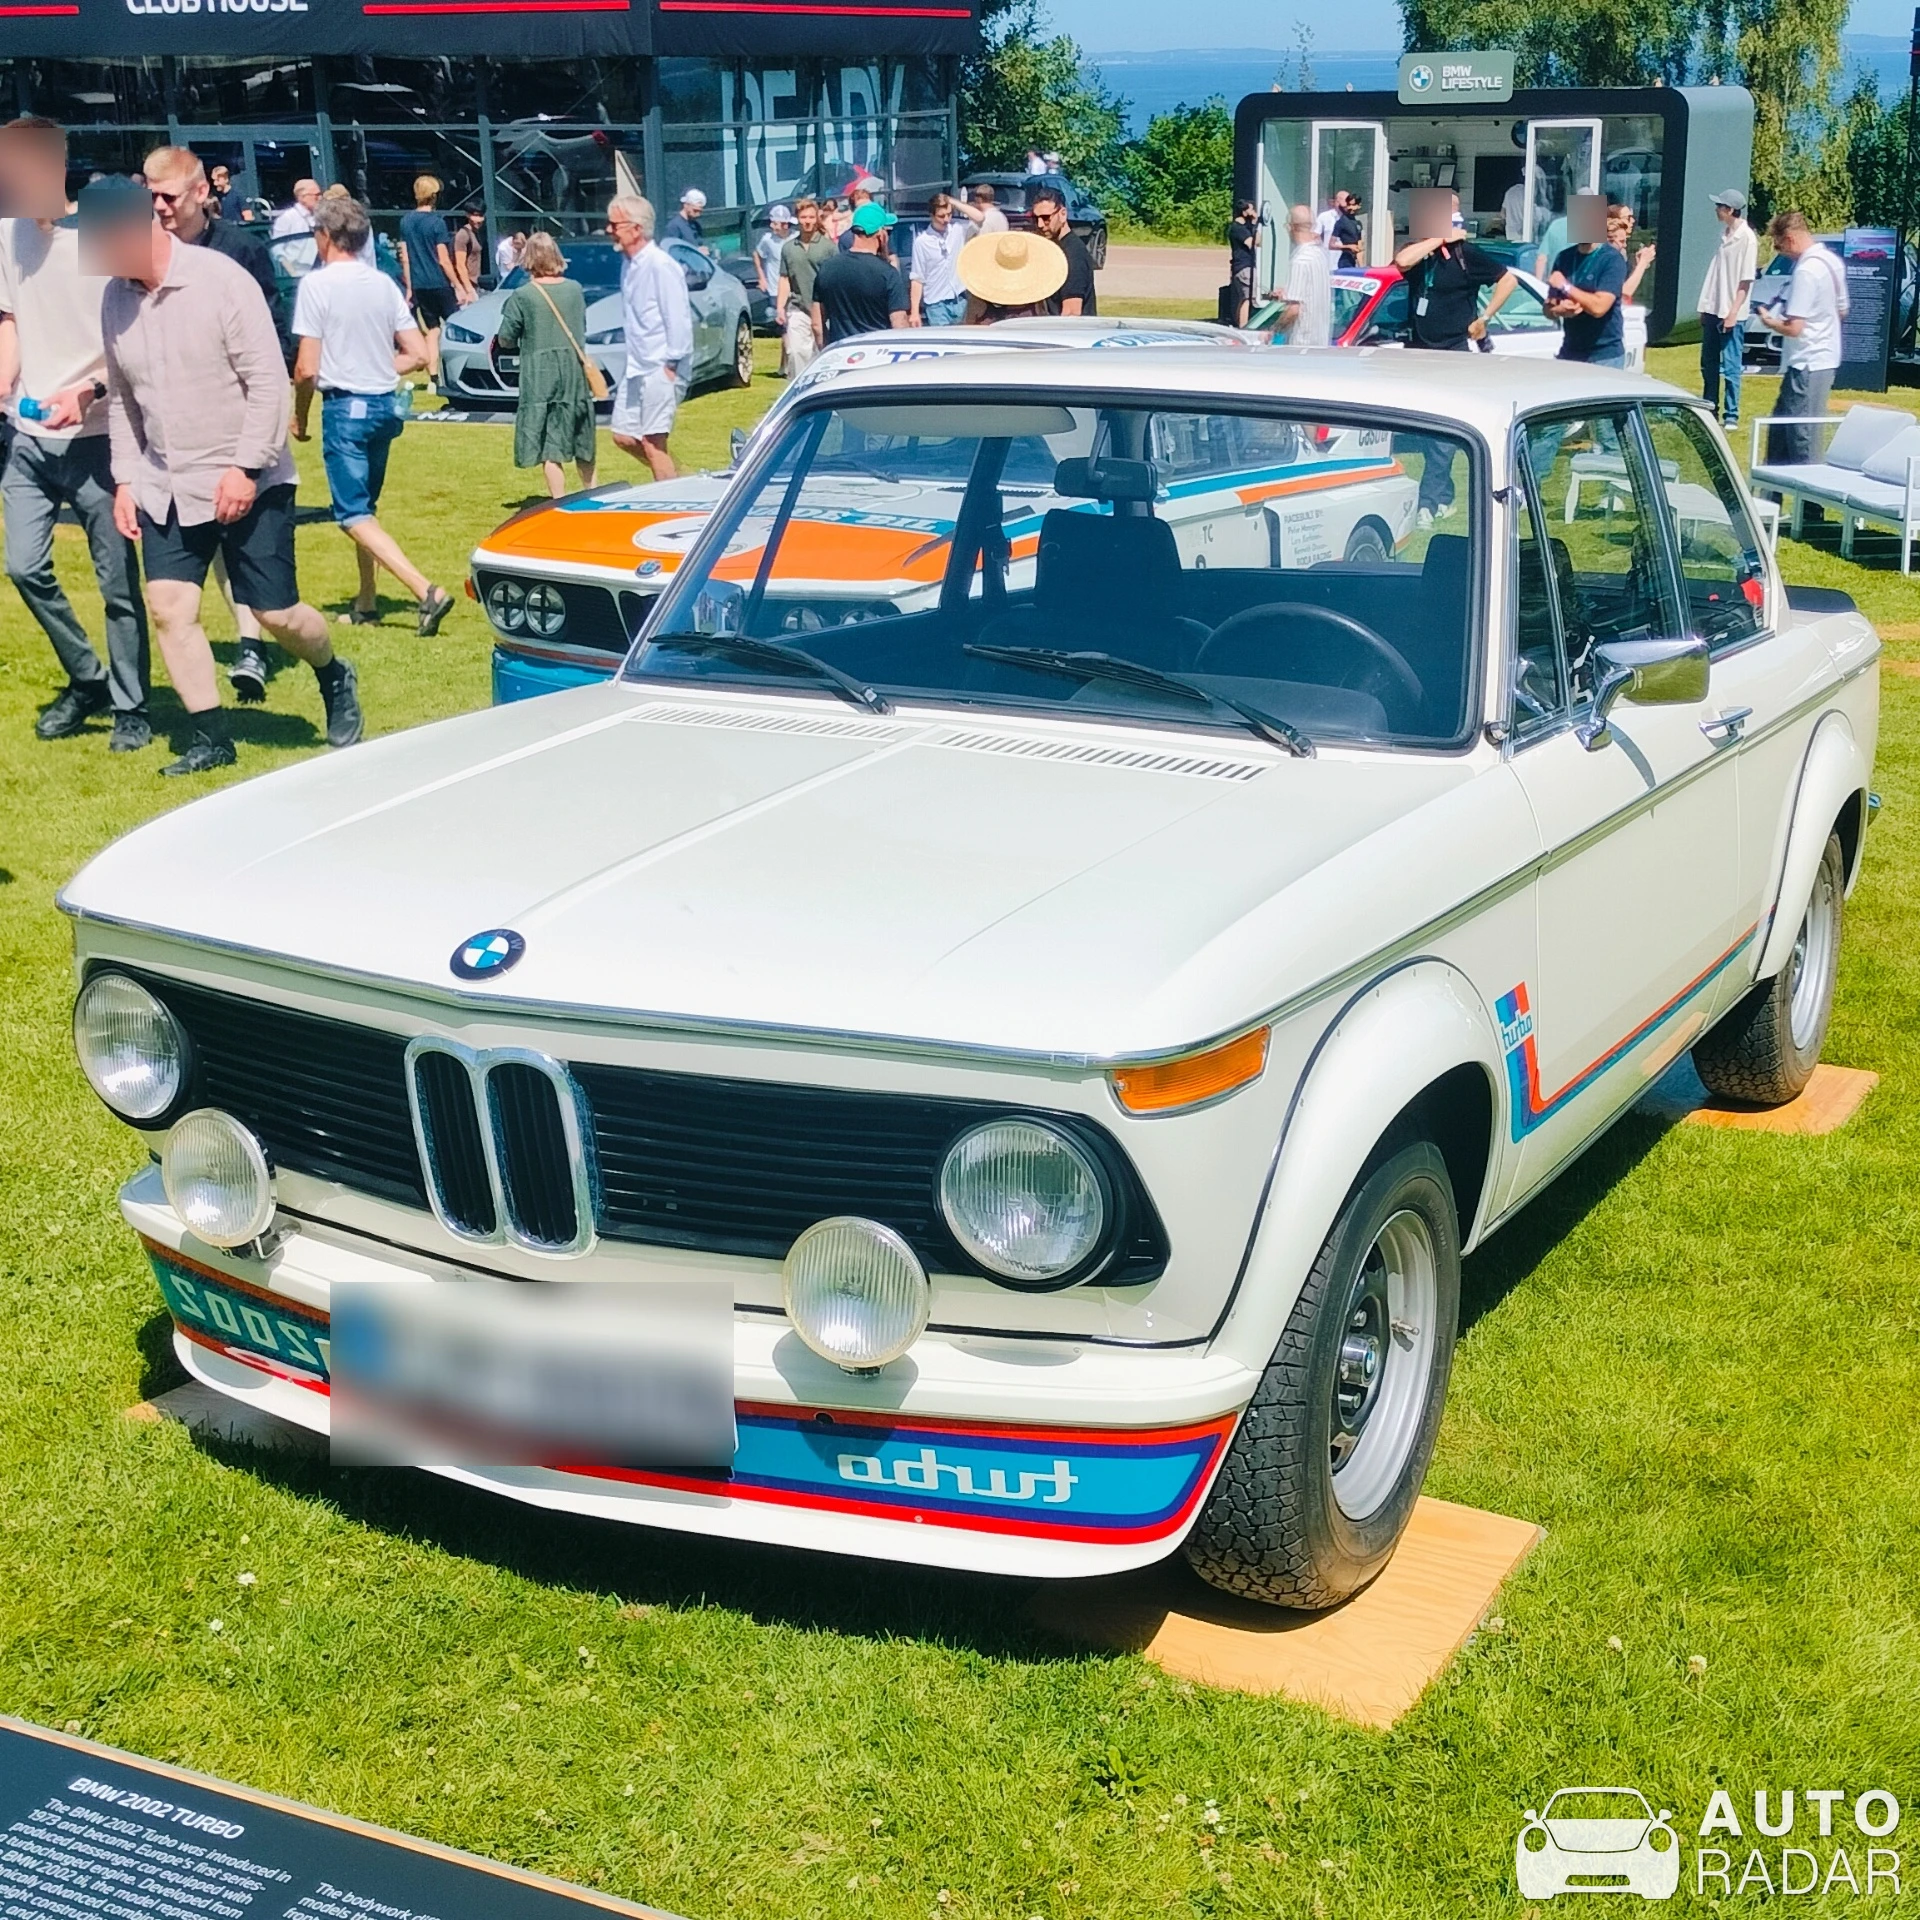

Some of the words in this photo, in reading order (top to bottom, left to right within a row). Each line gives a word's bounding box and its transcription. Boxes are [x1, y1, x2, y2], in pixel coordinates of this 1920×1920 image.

[1441, 76, 1503, 90] LIFESTYLE
[1442, 65, 1472, 77] BMW
[720, 64, 905, 208] READY
[857, 513, 942, 532] BIL
[1500, 1015, 1533, 1050] turbo
[67, 1777, 126, 1802] BMW
[116, 1792, 175, 1818] 2002
[170, 1807, 245, 1839] TURBO
[28, 1808, 61, 1826] 1973
[56, 1820, 88, 1835] and
[135, 1843, 195, 1869] Europe's
[192, 1862, 222, 1879] first
[218, 1872, 267, 1891] series-
[45, 1797, 71, 1814] The
[68, 1805, 111, 1825] BMW
[102, 1817, 143, 1837] 2002
[140, 1827, 178, 1848] Turbo
[177, 1842, 207, 1857] was
[205, 1848, 280, 1879] introduced
[275, 1870, 292, 1883] in
[5, 1834, 95, 1870] turbocharged
[89, 1864, 137, 1886] engine.
[137, 1877, 214, 1909] Developed
[208, 1901, 244, 1919] from
[8, 1822, 75, 1847] produced
[67, 1840, 140, 1868] passenger
[137, 1862, 163, 1875] car
[160, 1869, 226, 1895] equipped
[222, 1889, 254, 1906] with
[0, 1883, 34, 1902] eight
[1, 1850, 43, 1869] BMW
[36, 1861, 78, 1881] 2002
[90, 1880, 116, 1895] the
[113, 1889, 162, 1909] model
[156, 1902, 220, 1920] repres
[39, 1882, 108, 1909] advanced
[315, 1882, 343, 1900] The
[341, 1891, 413, 1920] bodywork
[5, 1905, 39, 1920] and
[298, 1896, 352, 1919] models
